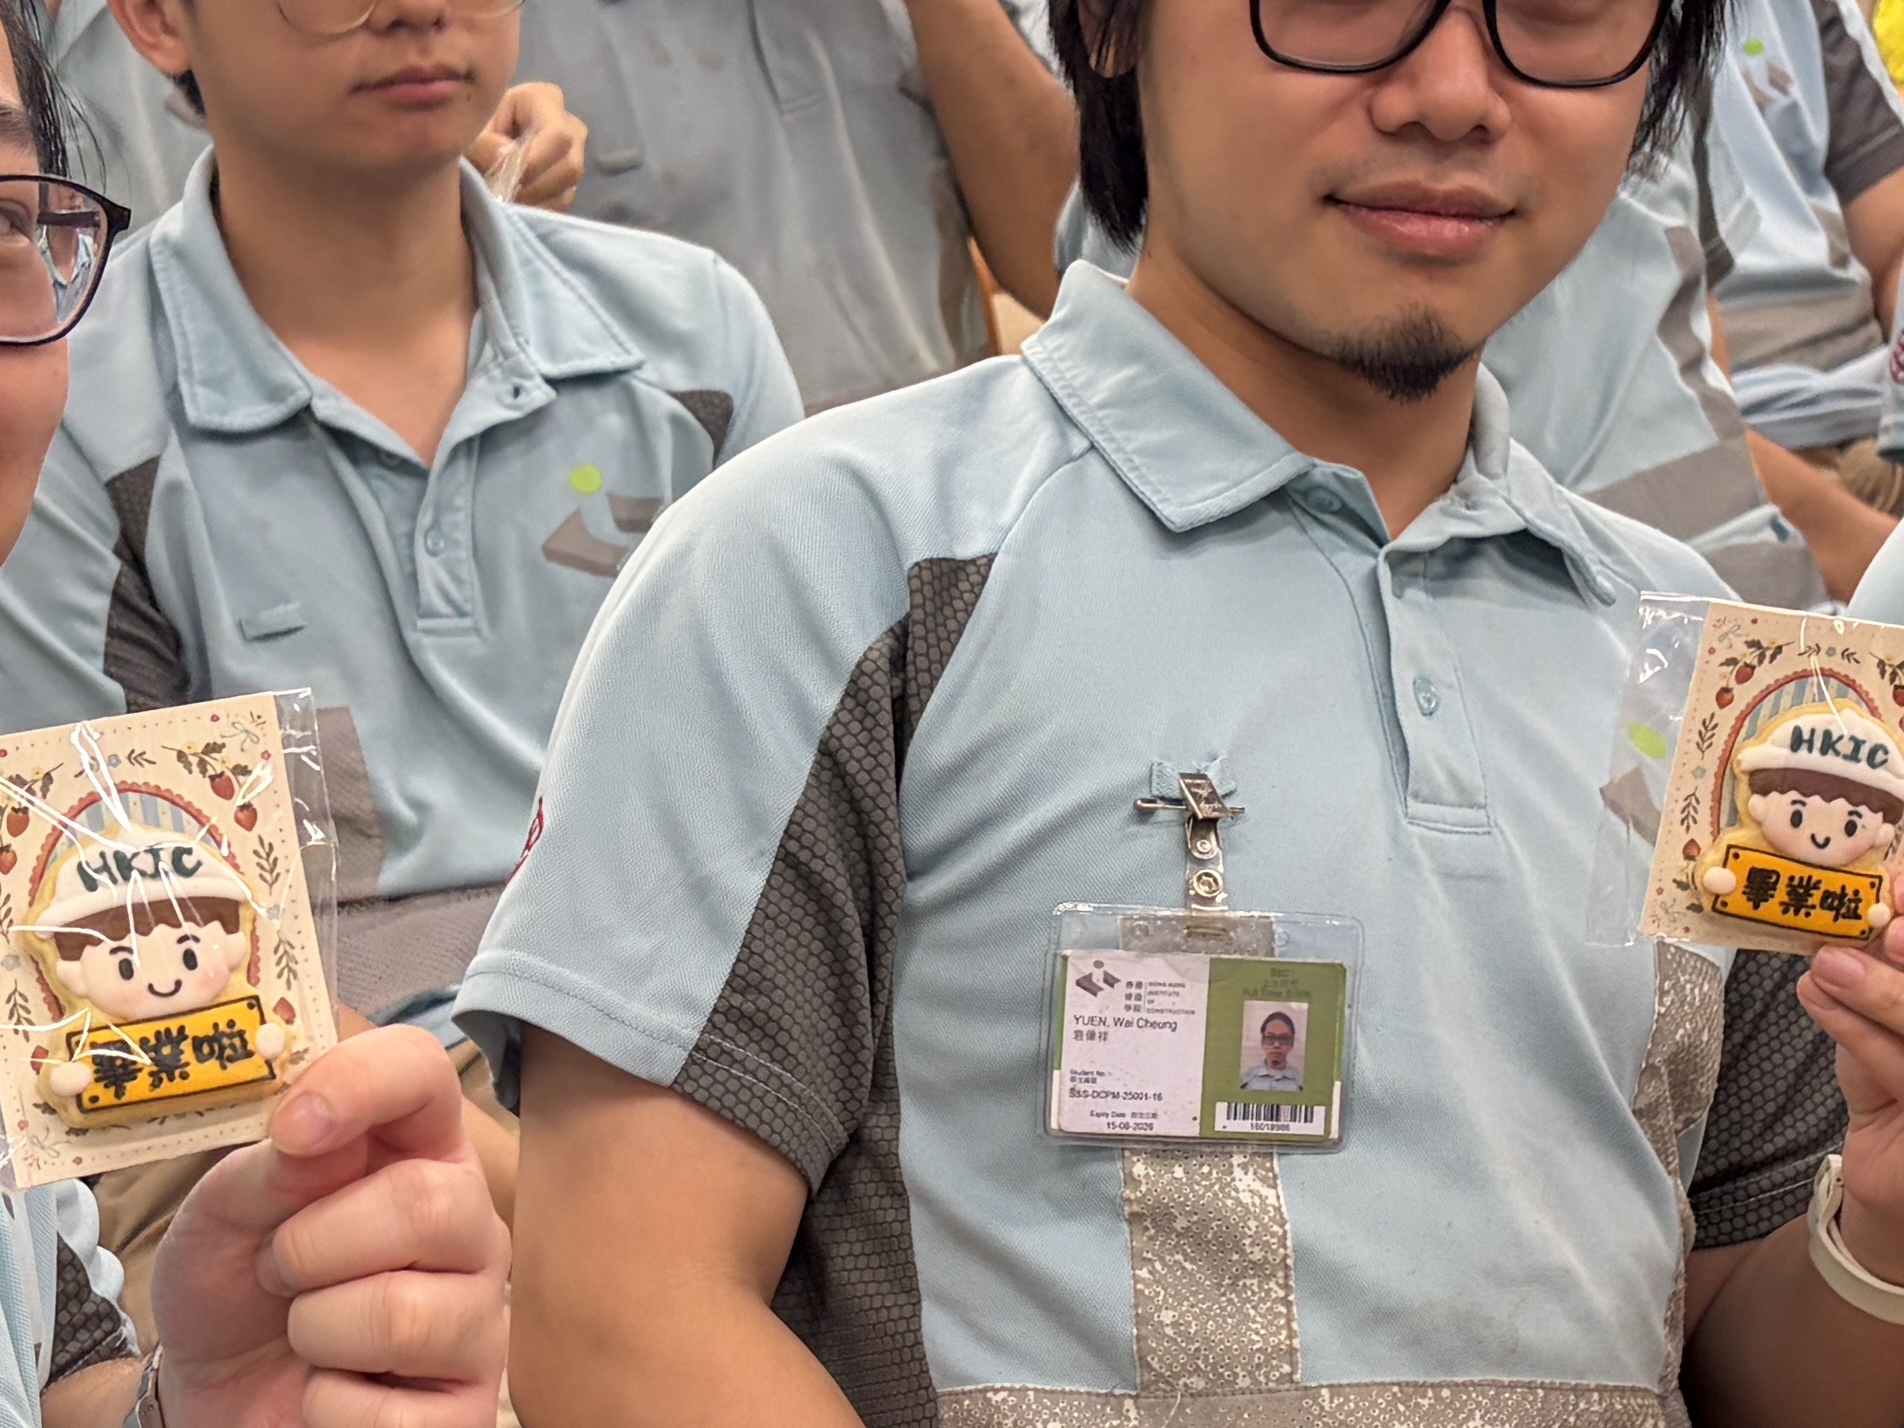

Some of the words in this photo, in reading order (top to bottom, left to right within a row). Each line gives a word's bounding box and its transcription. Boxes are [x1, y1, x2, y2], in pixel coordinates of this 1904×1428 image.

[1790, 724, 1889, 769] HKIC
[77, 845, 203, 892] HKIC
[1741, 866, 1863, 922] 畢業啦
[90, 1018, 256, 1100] 畢業啦
